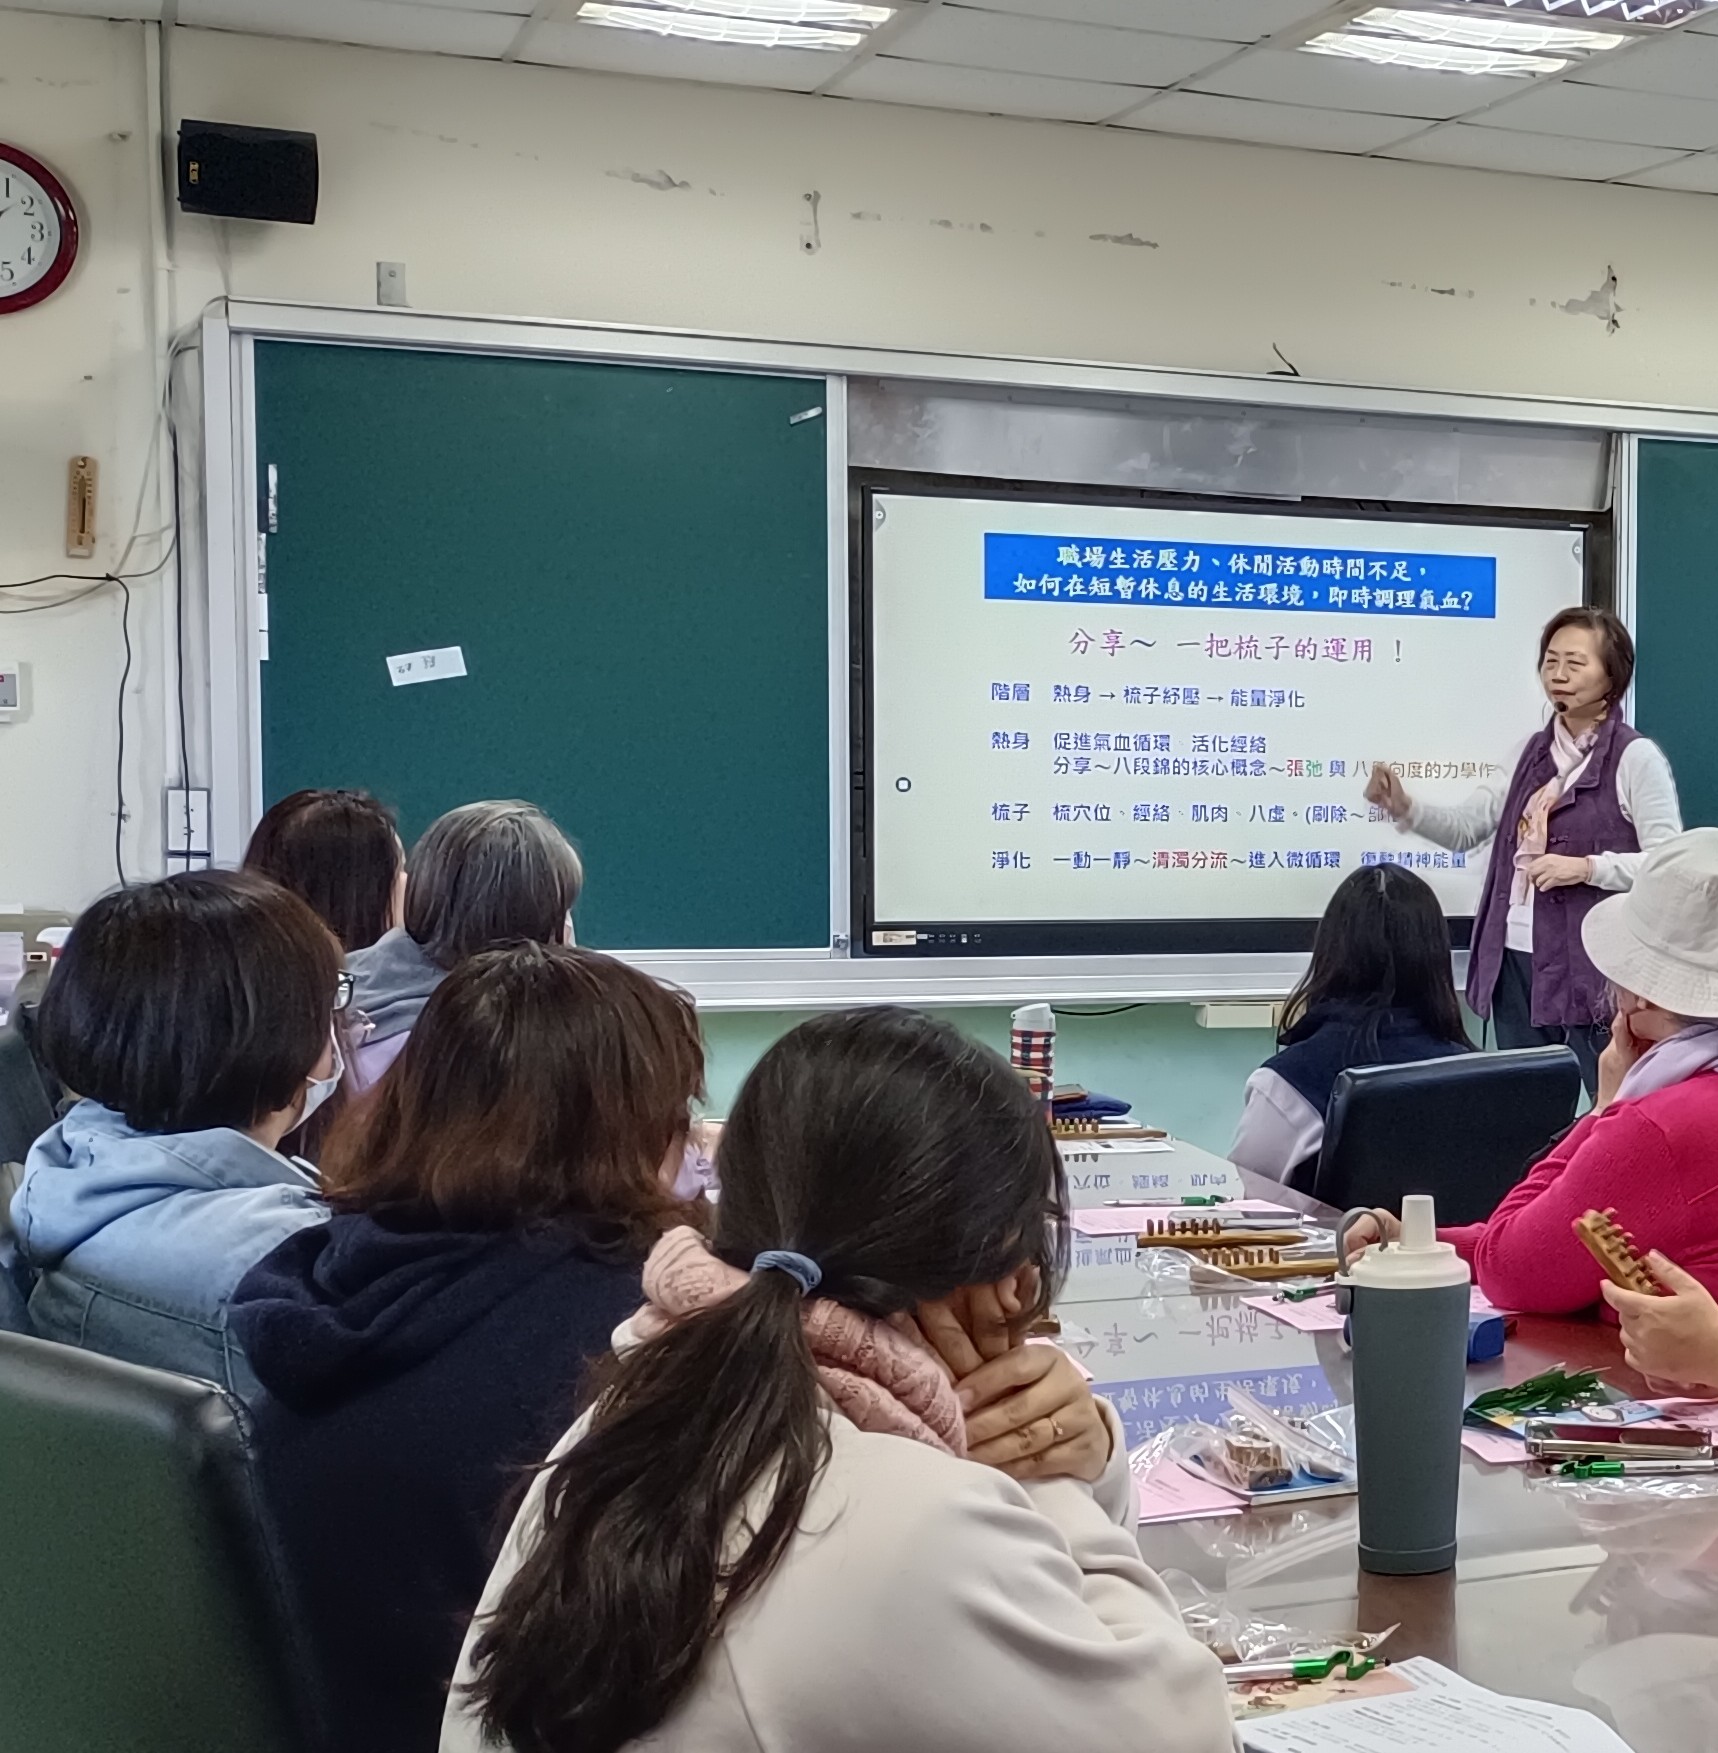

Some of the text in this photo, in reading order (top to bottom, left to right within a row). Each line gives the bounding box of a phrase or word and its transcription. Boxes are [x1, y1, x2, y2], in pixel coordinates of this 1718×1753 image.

[5, 177, 10, 198] 1
[20, 195, 35, 216] 2
[31, 221, 45, 242] 3
[21, 246, 36, 265] 4
[0, 261, 14, 281] 5
[1177, 633, 1373, 663] 一把梳子的運用
[991, 683, 1306, 708] 階層 熱身 梳子紓壓 能量淨化
[991, 731, 1030, 751] 熱身
[1352, 760, 1496, 779] 八向度的力學作
[991, 803, 1031, 822] 梳子
[992, 850, 1031, 870] 淨化
